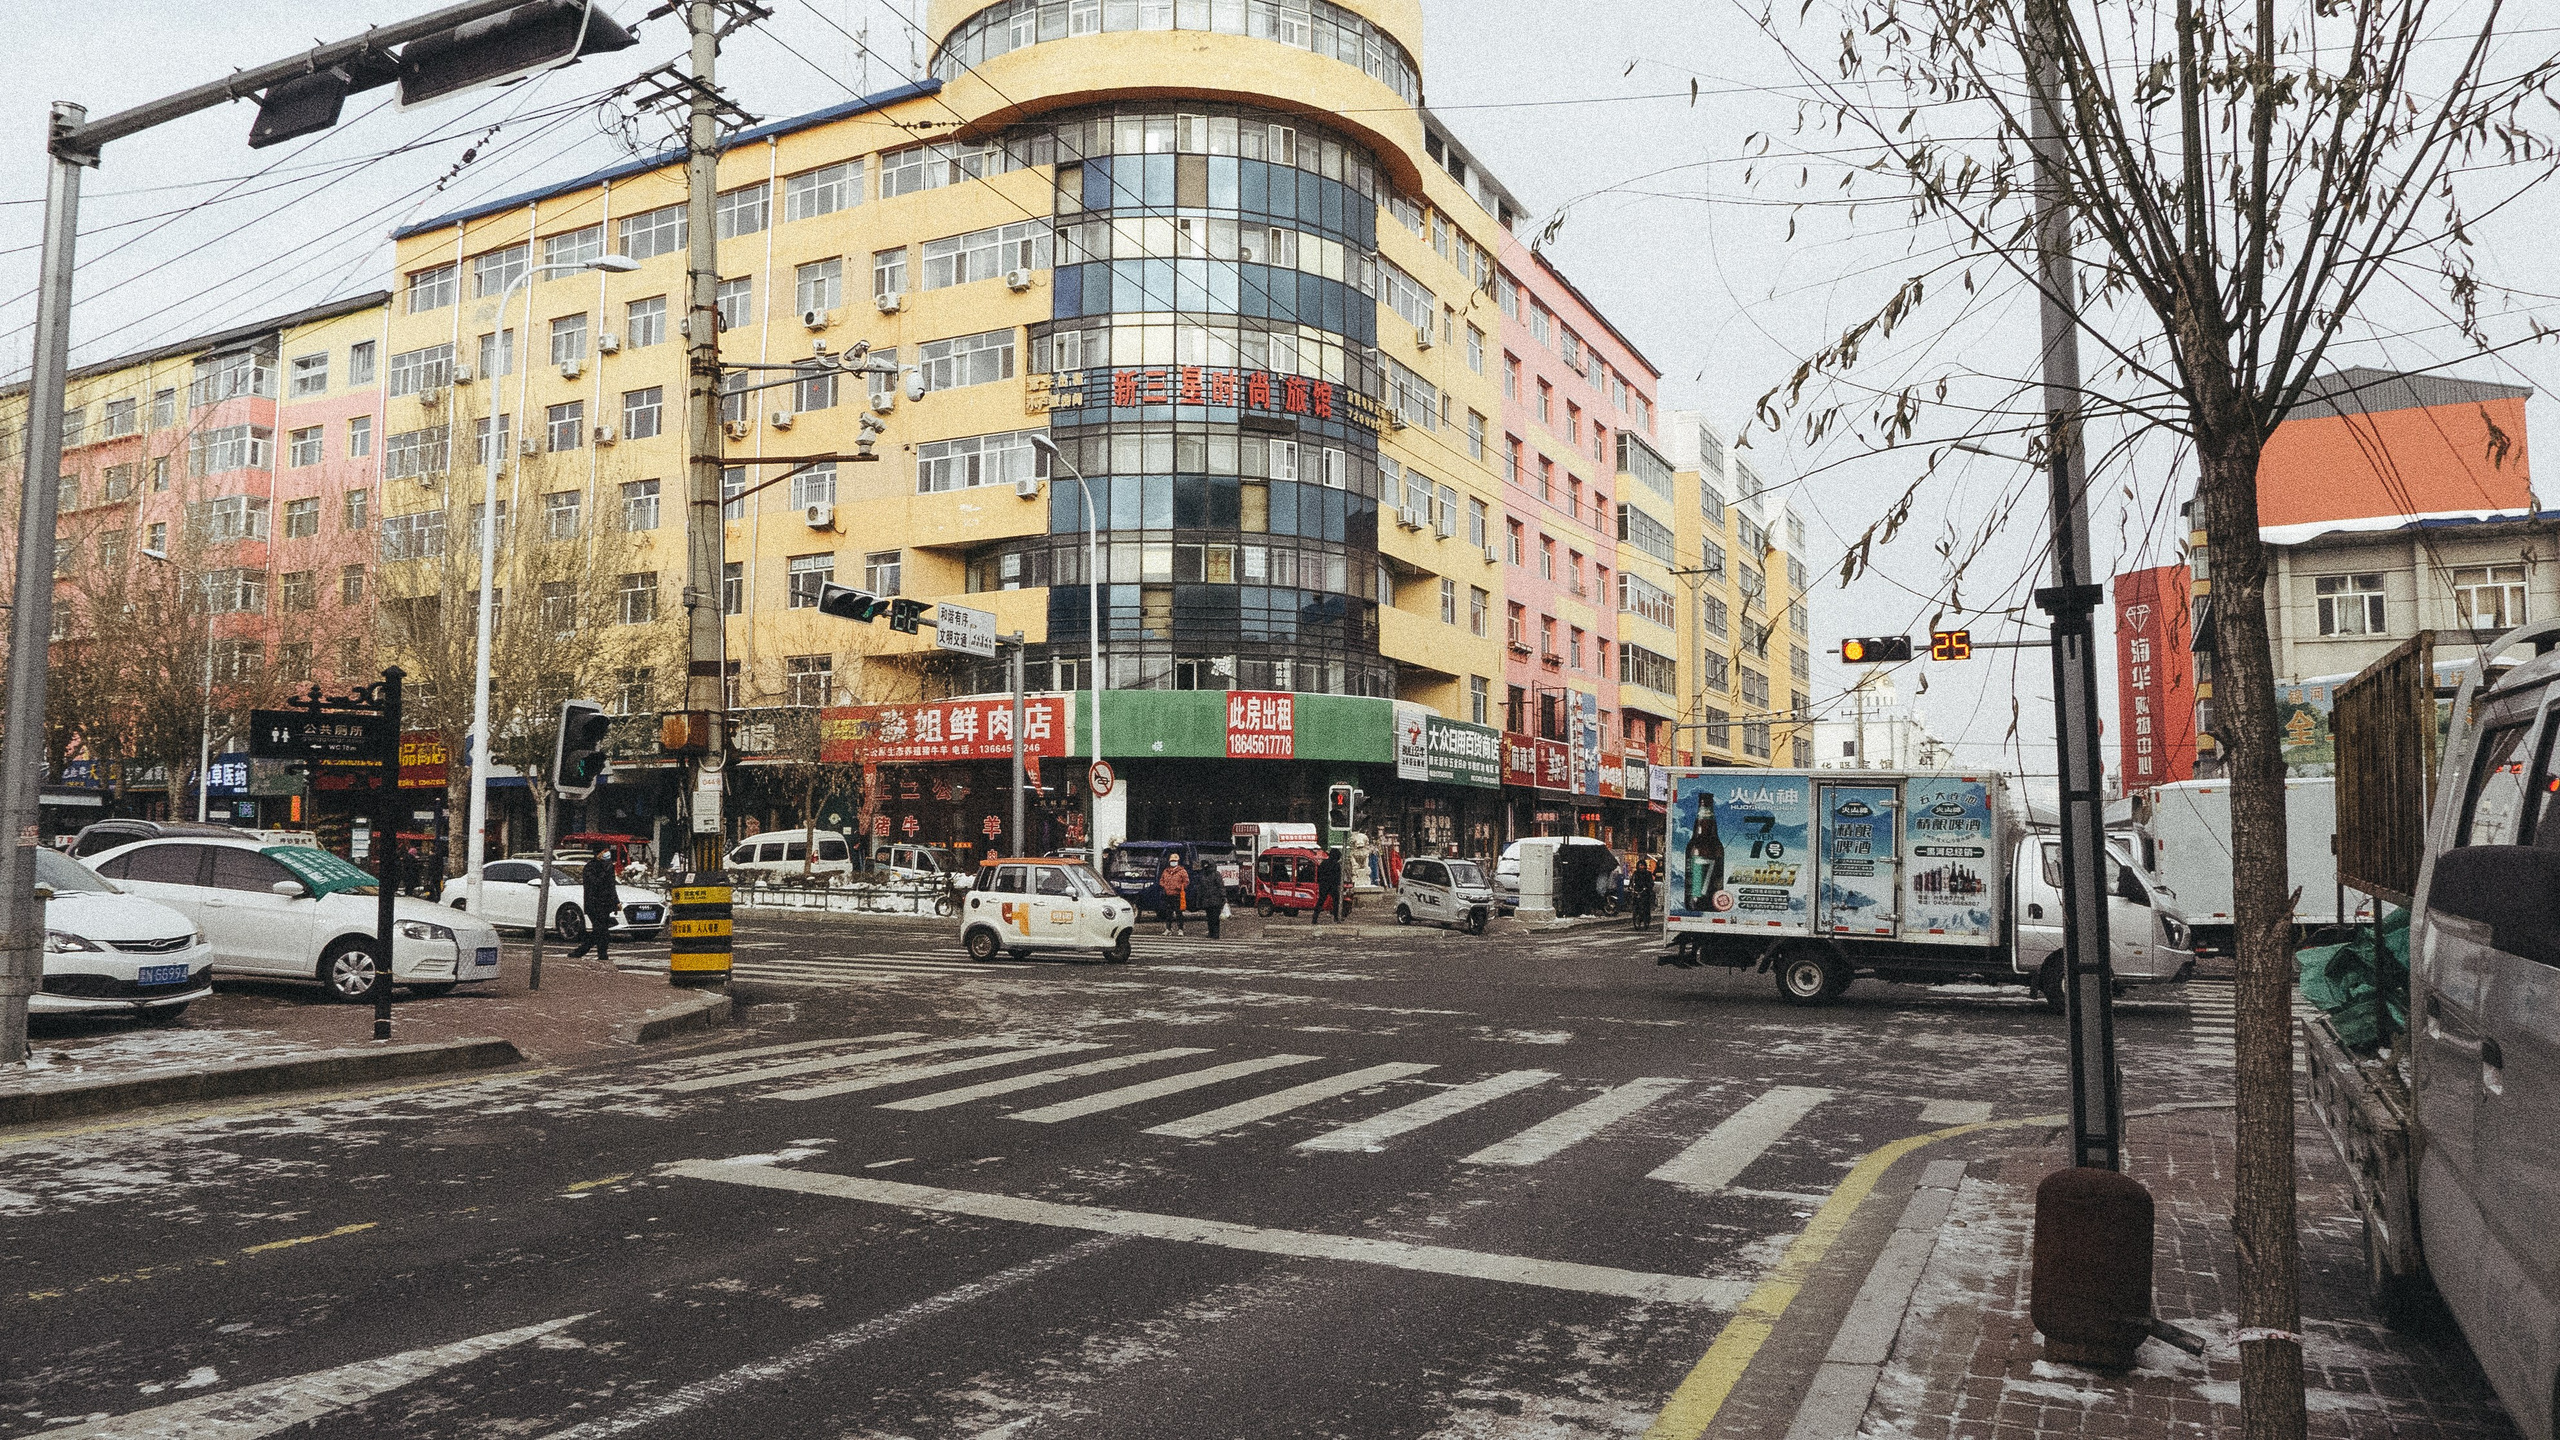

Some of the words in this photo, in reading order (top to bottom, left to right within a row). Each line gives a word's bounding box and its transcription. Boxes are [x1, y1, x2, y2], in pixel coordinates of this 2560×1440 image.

[1114, 366, 1332, 419] 新三星时尚旅馆
[940, 607, 969, 627] 和谐有序
[939, 629, 967, 648] 文明交通
[1934, 632, 1969, 660] 25
[1229, 696, 1292, 730] 此房出租
[303, 723, 363, 737] 公共厕所
[979, 743, 1040, 754] 136645246
[1229, 734, 1292, 754] 18645617778
[1429, 725, 1499, 761] 大众日用百货商店
[399, 743, 447, 766] 品商店
[1729, 787, 1799, 805] 火山神
[1835, 823, 1873, 838] 精酿
[1916, 818, 1980, 831] 精酿啤酒
[1744, 833, 1774, 841] SEVEN
[1835, 839, 1872, 854] 啤酒
[1413, 891, 1441, 906] YUE
